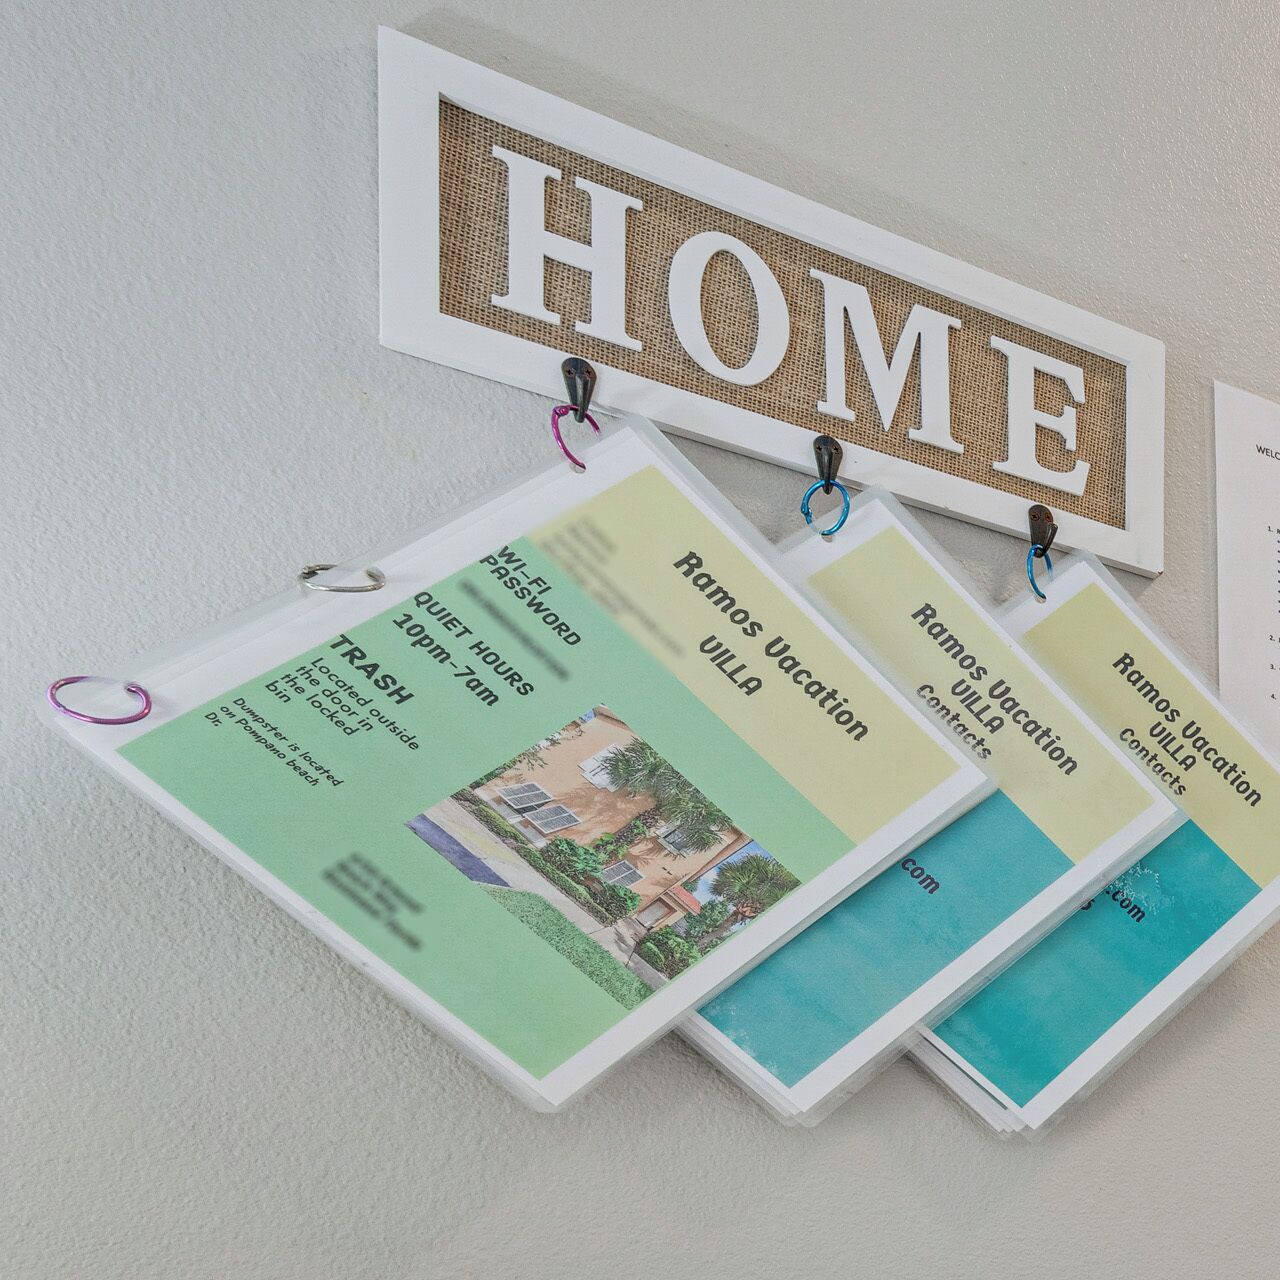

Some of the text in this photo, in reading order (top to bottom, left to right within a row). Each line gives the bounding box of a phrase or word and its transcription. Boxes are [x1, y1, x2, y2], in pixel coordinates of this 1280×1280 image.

[490, 145, 1090, 497] HOME
[479, 554, 581, 645] PASSWORD
[497, 545, 552, 595] WI-FI
[330, 634, 415, 705] TRASH
[392, 613, 499, 706] 10pm-7am
[414, 592, 473, 638] QUIET
[468, 640, 534, 696] HOURS
[673, 551, 763, 637] Ramos
[765, 636, 868, 741] Vacation
[700, 635, 762, 696] VILLA
[204, 712, 222, 726] Dr.
[265, 680, 291, 703] bin
[280, 673, 360, 736] the locked
[295, 666, 373, 731] the door in
[311, 657, 419, 750] Located outside
[911, 603, 1077, 775] Ramos Vacation
[917, 684, 991, 759] Contacts
[951, 678, 1004, 734] VILLA
[220, 706, 319, 786] on Pompano beach
[233, 698, 344, 786] Dumpster is located
[1112, 652, 1261, 807] Ramos Vacation
[1120, 728, 1186, 795] Contacts
[1149, 721, 1196, 772] VILLA
